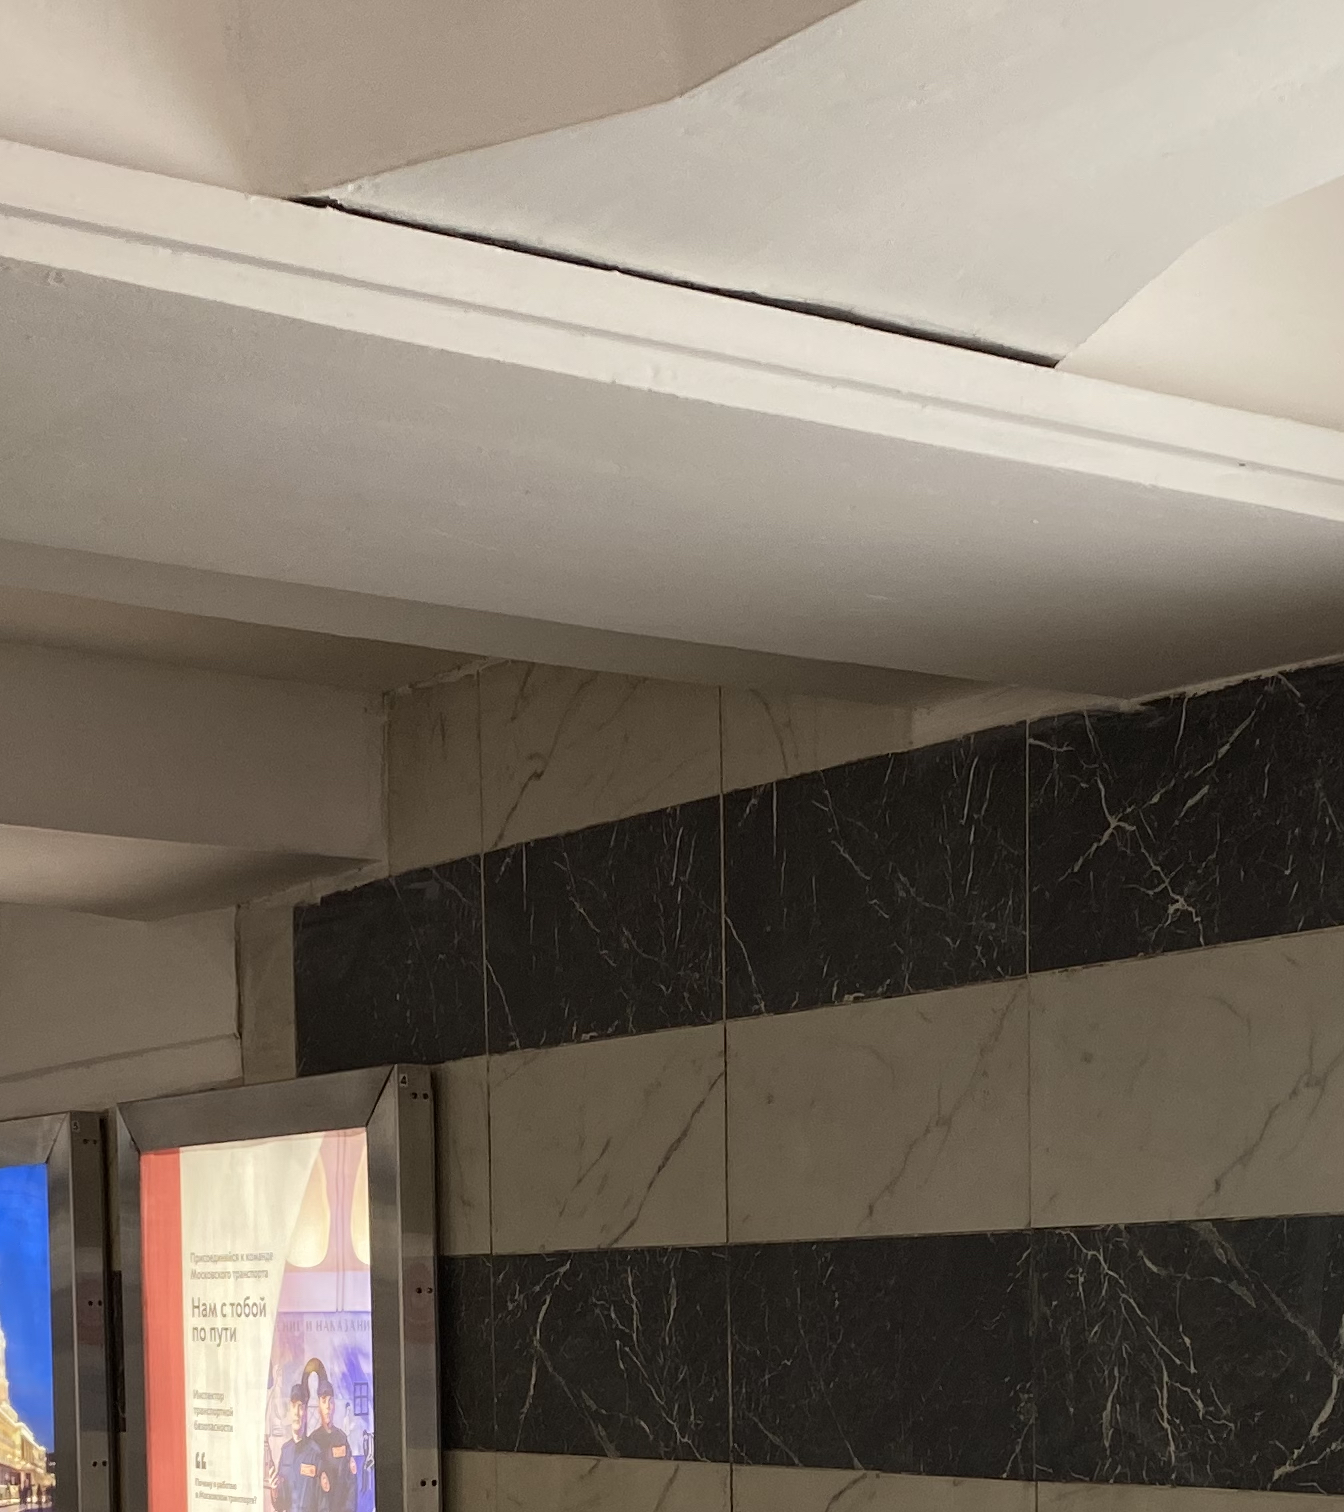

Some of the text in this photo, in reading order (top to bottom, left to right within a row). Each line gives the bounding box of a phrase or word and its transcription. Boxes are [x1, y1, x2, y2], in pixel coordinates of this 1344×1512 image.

[191, 1296, 267, 1318] Нам с тобой
[191, 1326, 237, 1347] по пути
